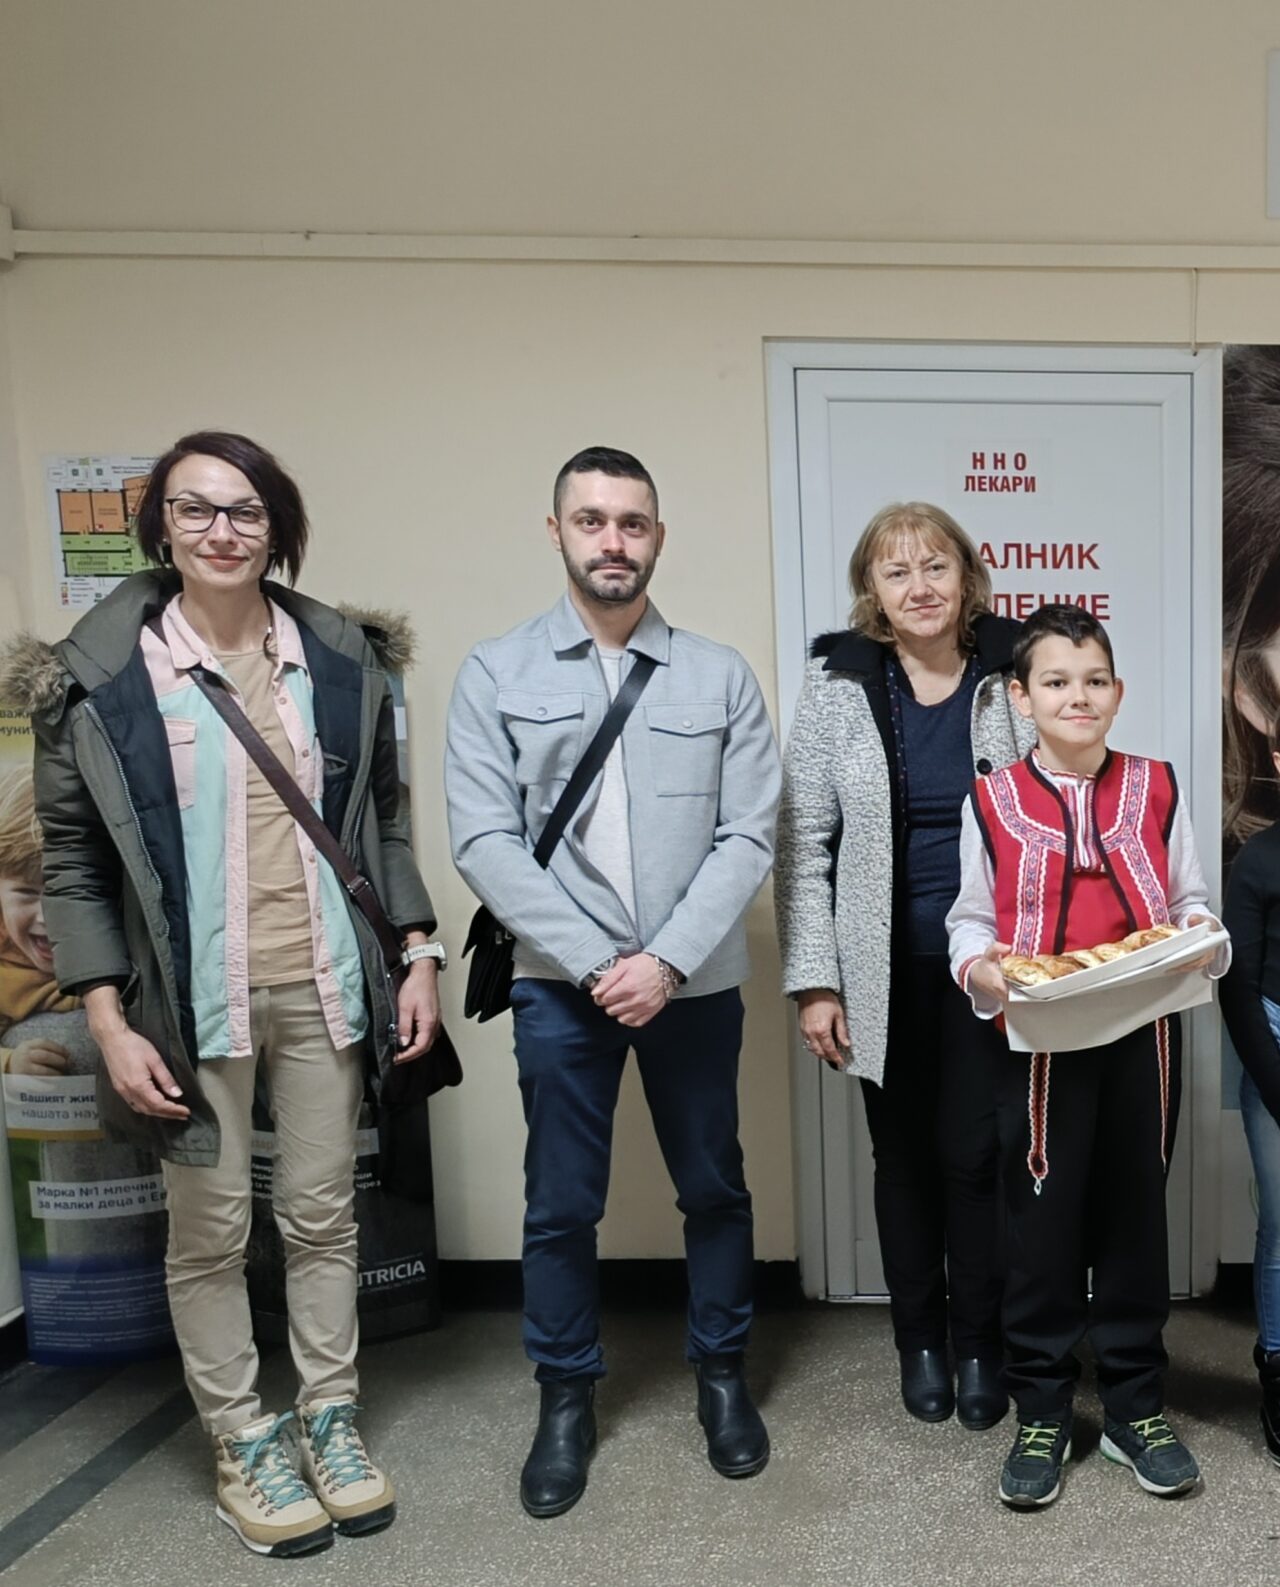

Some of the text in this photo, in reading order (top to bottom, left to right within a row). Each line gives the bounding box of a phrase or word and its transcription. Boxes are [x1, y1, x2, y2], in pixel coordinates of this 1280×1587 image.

[964, 475, 1036, 493] ЛЕКАРИ
[980, 542, 1100, 570] АЛНИК
[74, 1109, 99, 1121] нау
[37, 1187, 75, 1199] Марка
[358, 1260, 426, 1288] TRICIA
